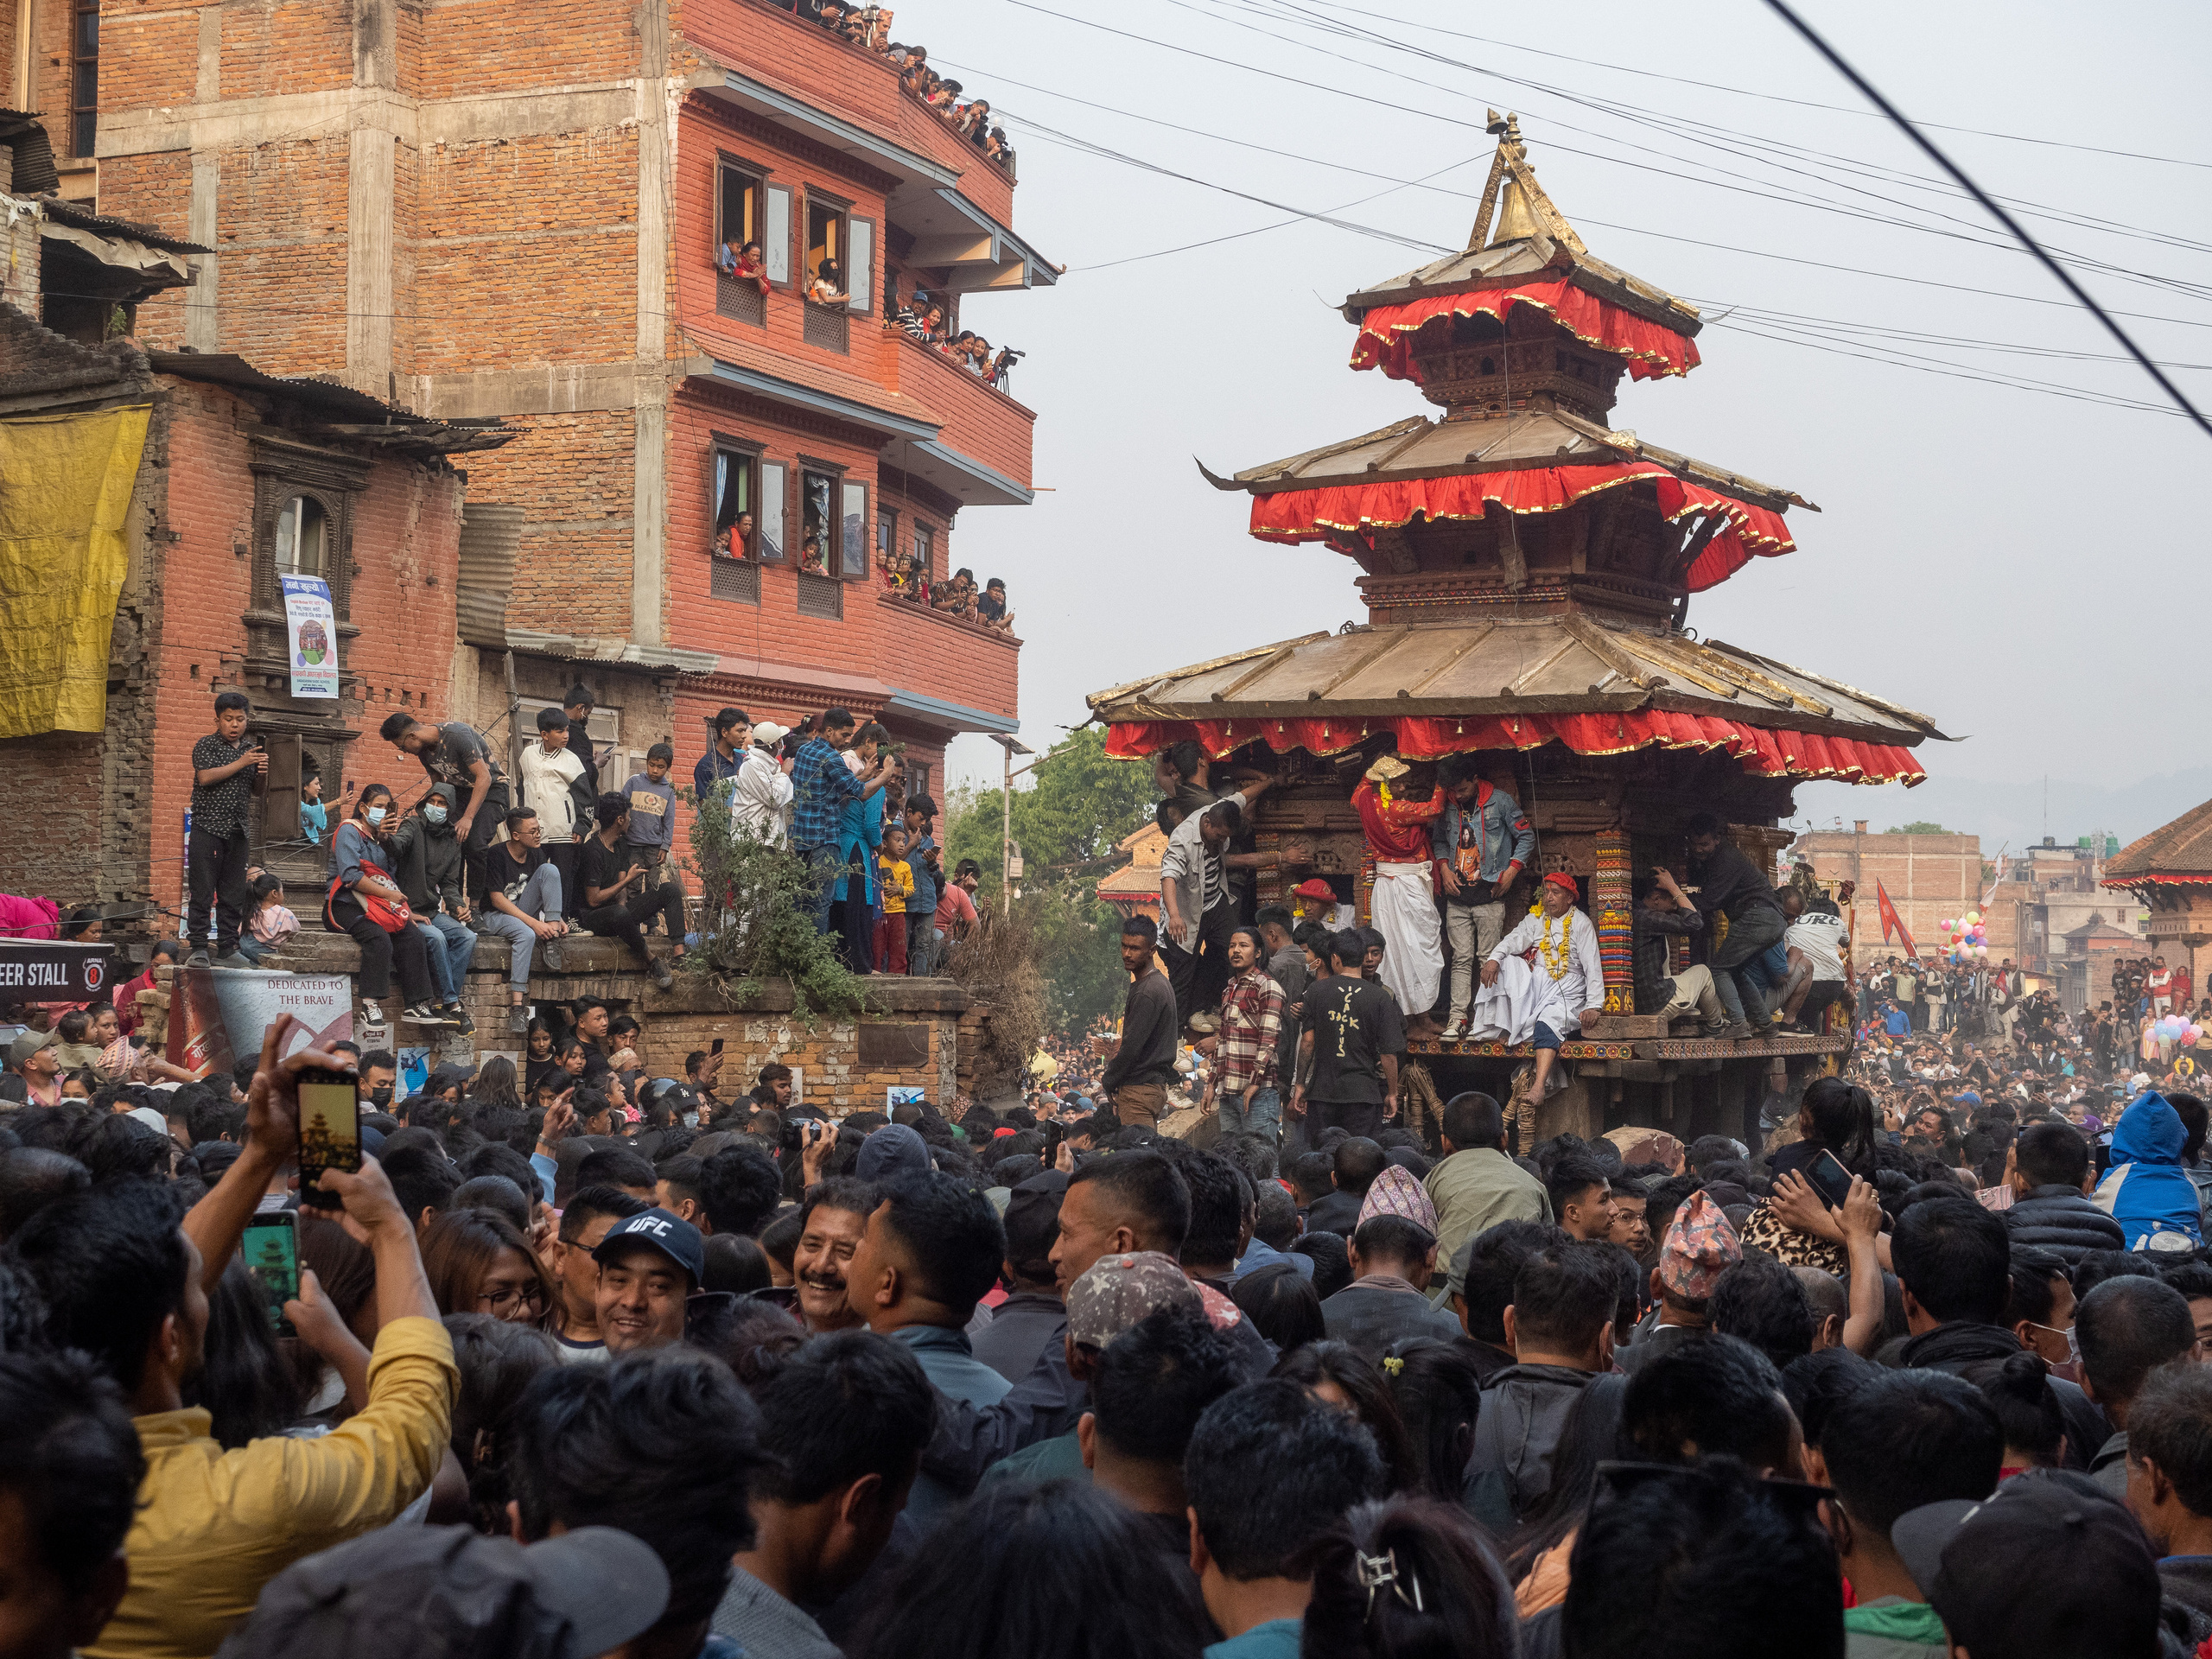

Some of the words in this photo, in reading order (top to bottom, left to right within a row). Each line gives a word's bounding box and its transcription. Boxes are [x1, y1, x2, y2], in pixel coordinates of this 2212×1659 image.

[28, 963, 68, 986] STALL
[90, 968, 97, 983] 8
[268, 980, 326, 990] DEDICATED
[328, 981, 343, 990] TO
[279, 995, 300, 1004] THE
[304, 995, 334, 1005] BRAVE
[625, 1216, 673, 1236] UFC
